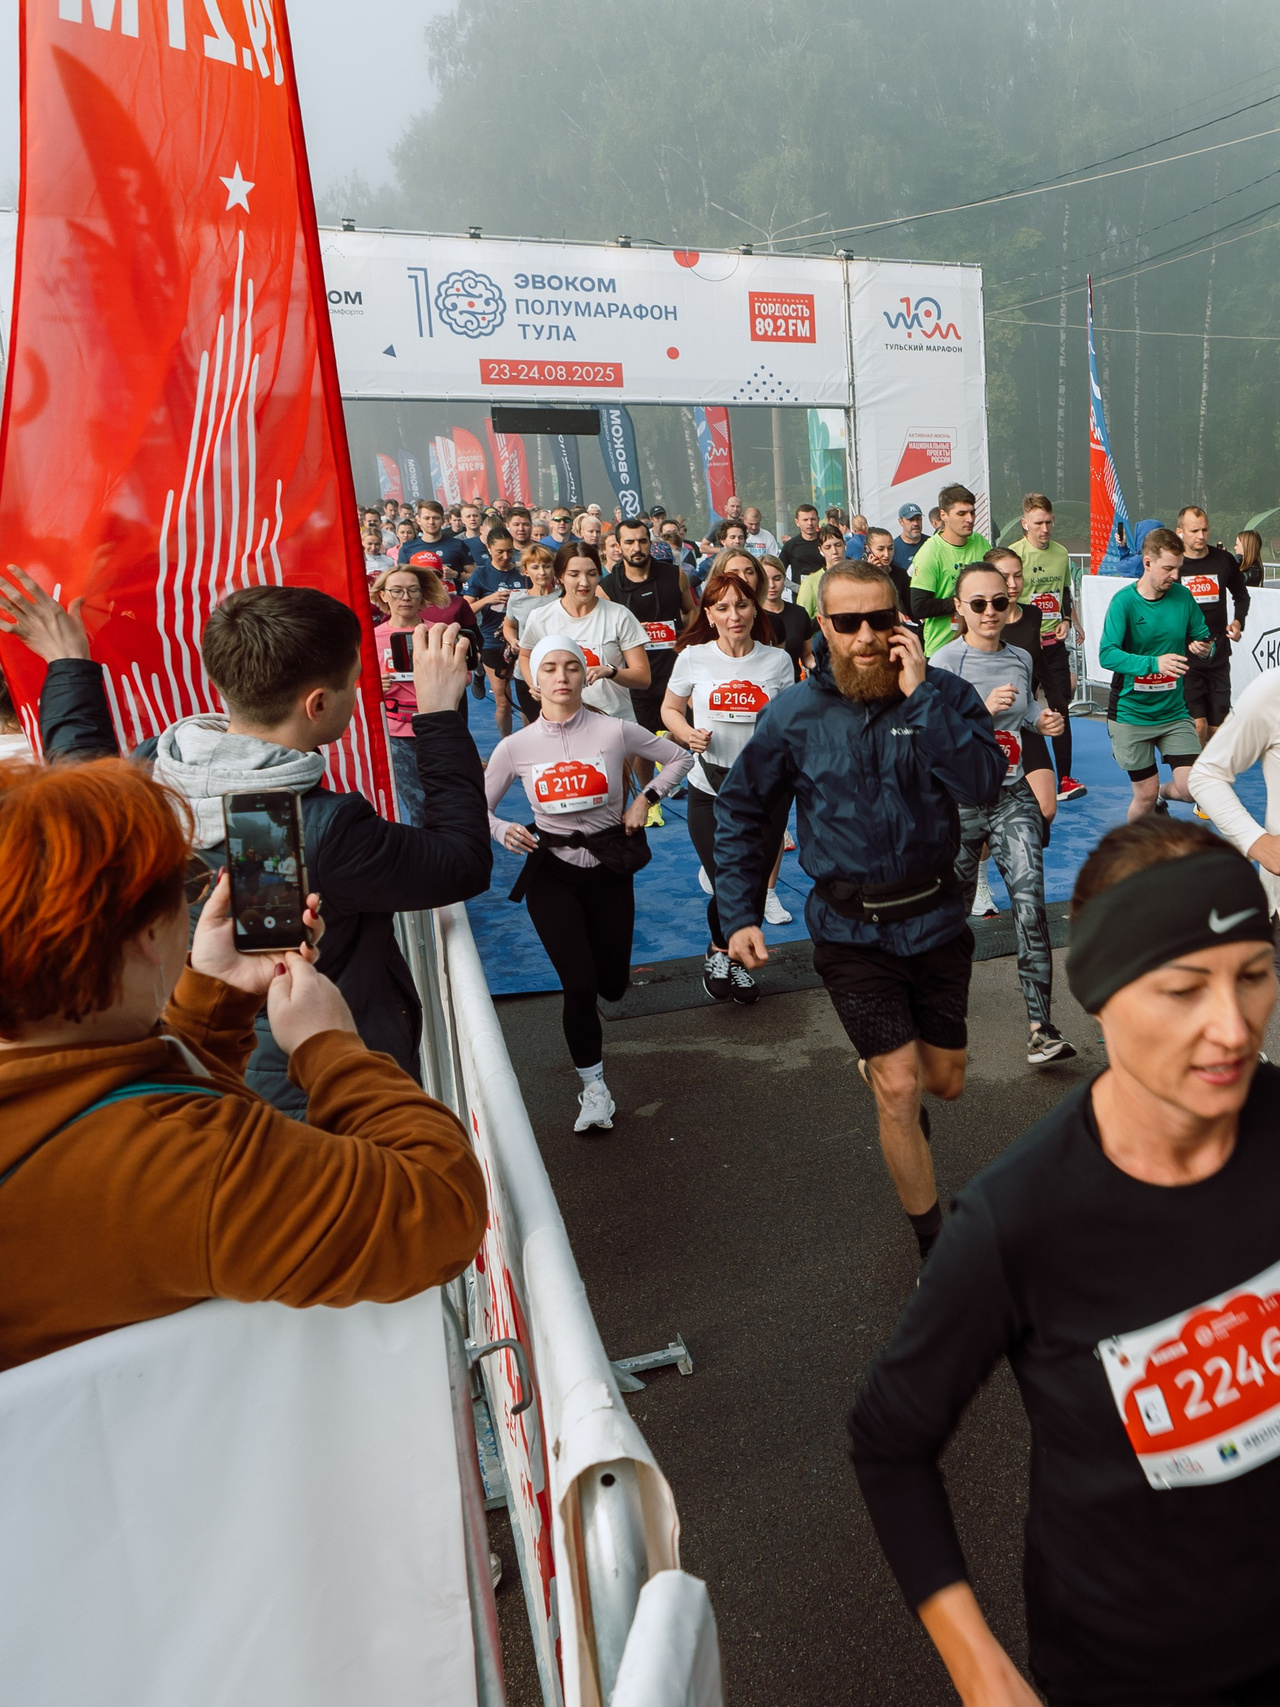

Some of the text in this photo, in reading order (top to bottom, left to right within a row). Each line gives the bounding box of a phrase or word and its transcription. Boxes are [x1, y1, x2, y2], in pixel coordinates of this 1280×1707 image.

[513, 272, 617, 293] ЭВОКОМ
[515, 298, 678, 321] ПОЛУМАРАФОН
[754, 302, 810, 317] ГОРДОСТЬ
[517, 323, 577, 342] ТУЛА
[755, 317, 810, 337] 89.2 FM
[884, 343, 963, 353] ТУЛЬСКИЙ МАРАФОН
[488, 363, 615, 383] 23-24.08.2025
[724, 692, 756, 705] 2164
[553, 774, 587, 793] 2117
